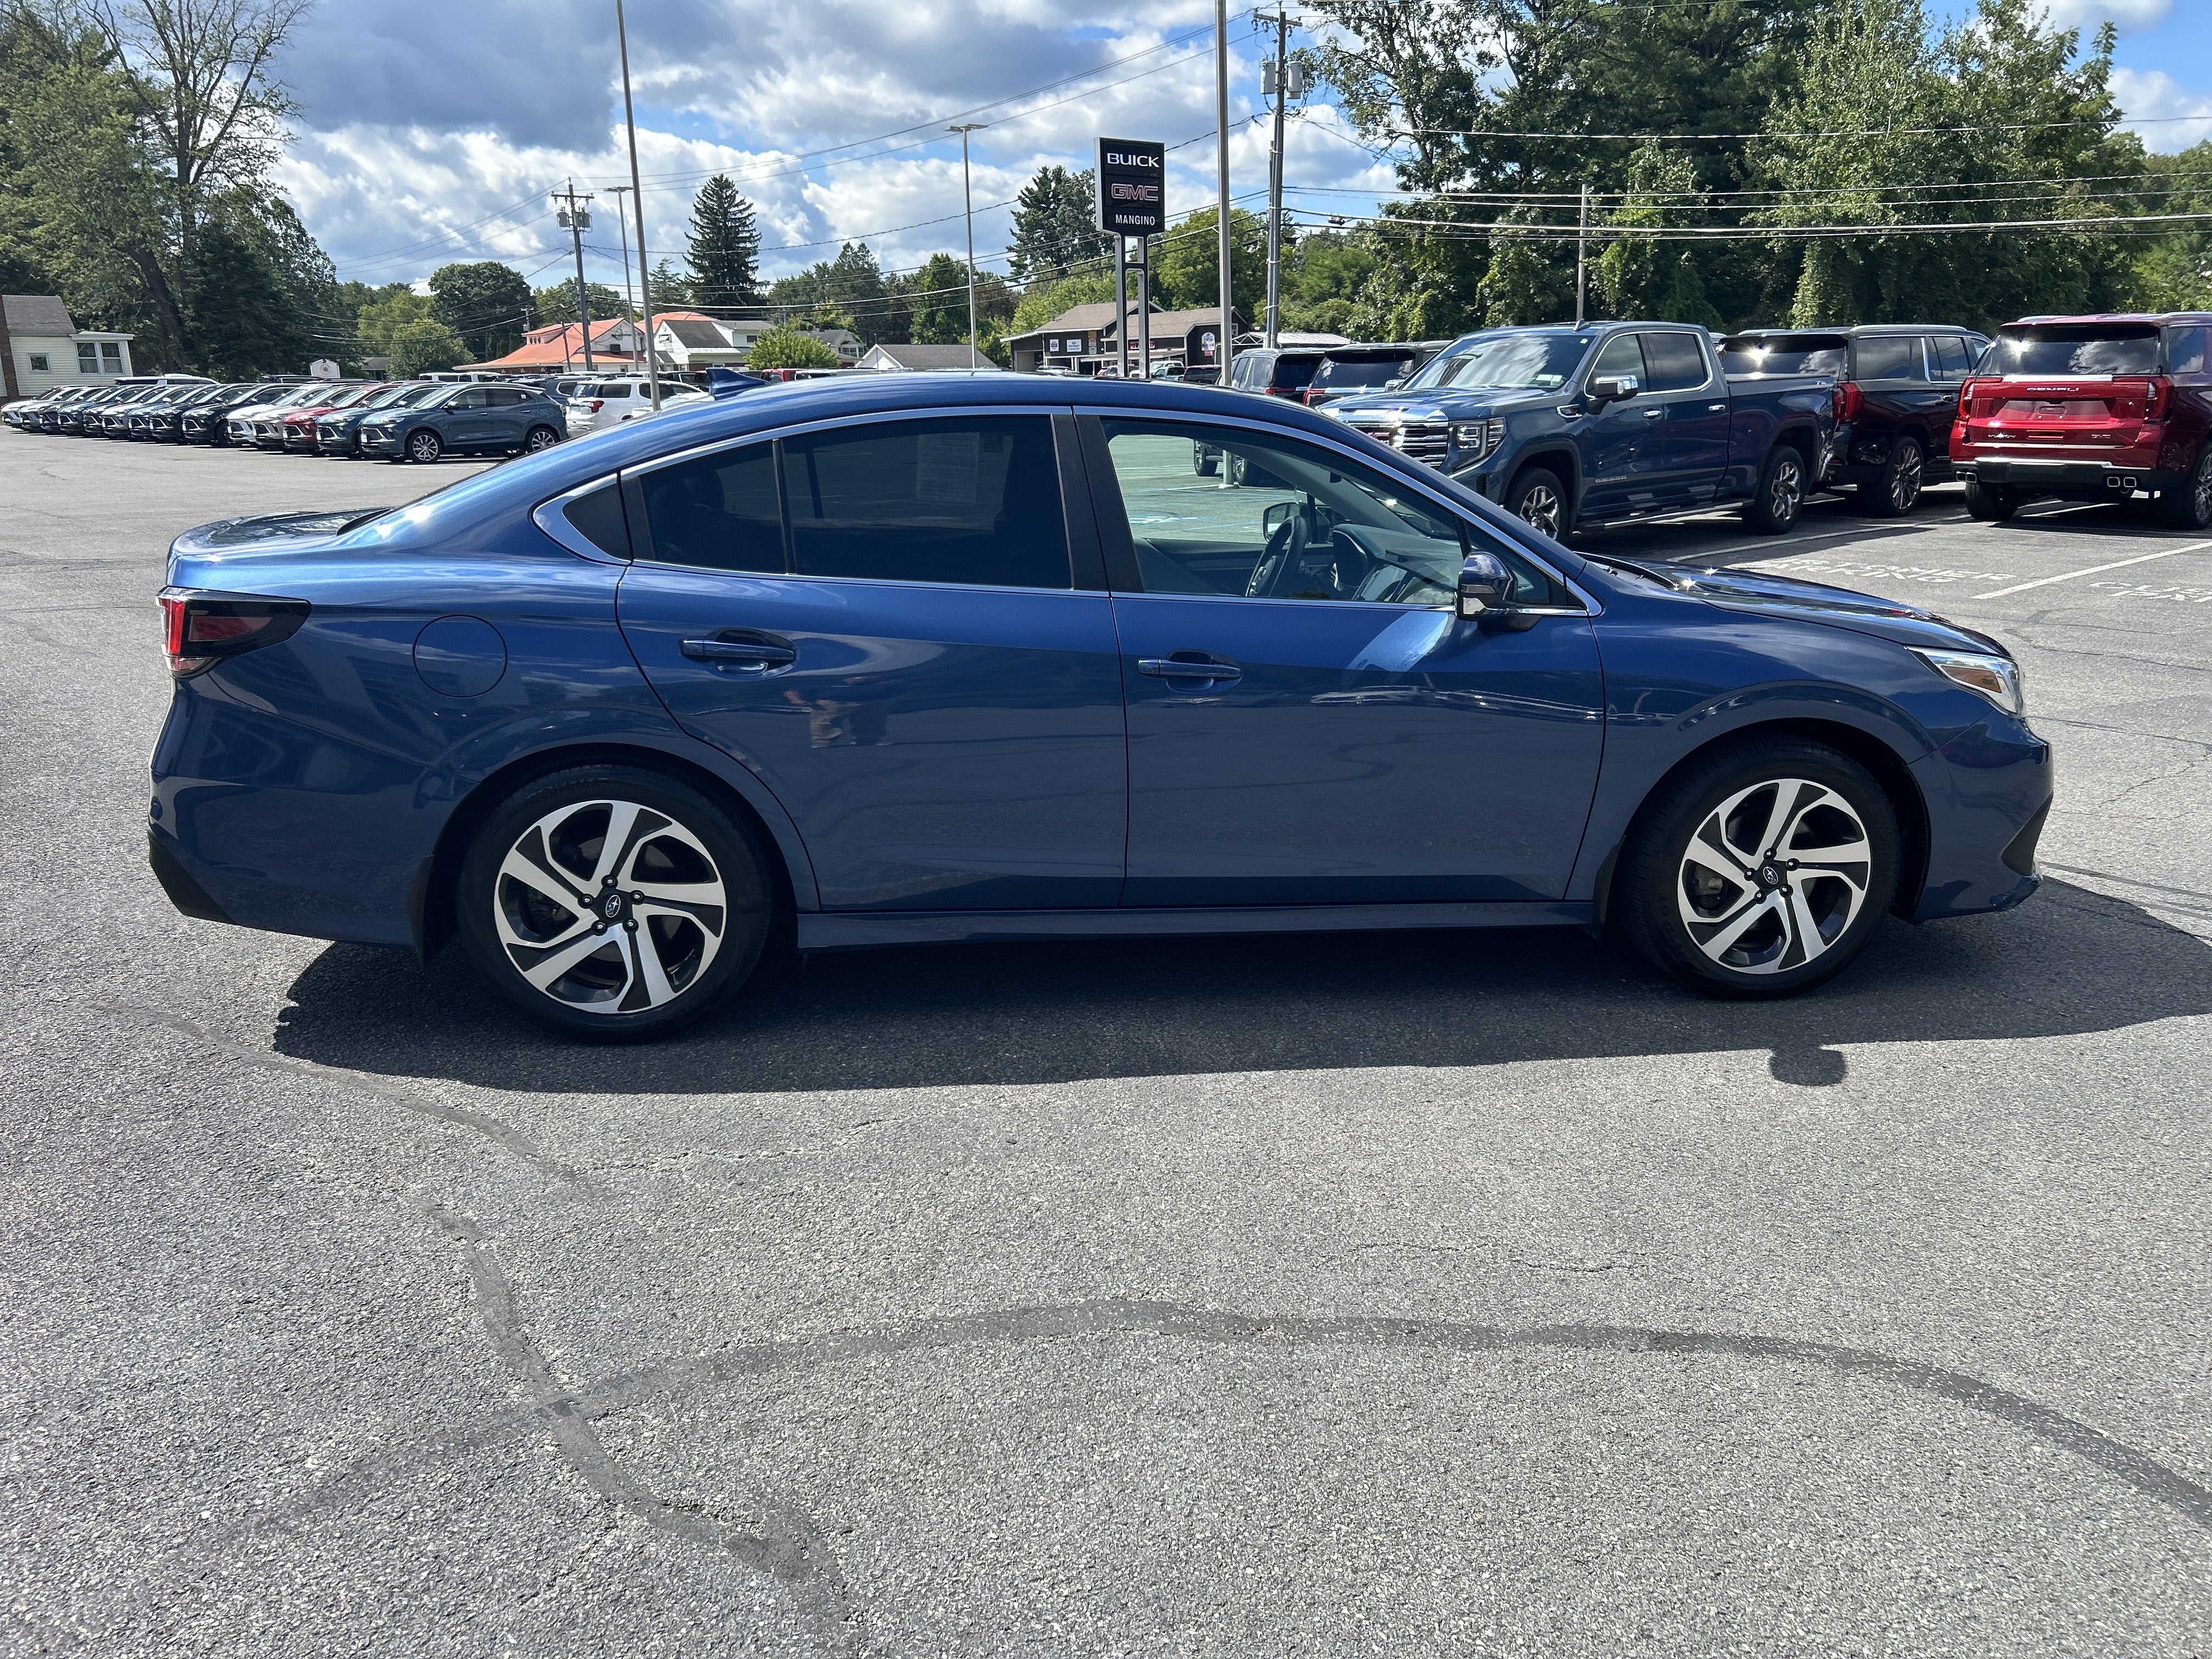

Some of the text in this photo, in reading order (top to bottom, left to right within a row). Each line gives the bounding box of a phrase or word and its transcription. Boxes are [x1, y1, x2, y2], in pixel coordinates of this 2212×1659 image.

[1107, 153, 1160, 168] BUICK
[1111, 183, 1159, 201] GMC
[1115, 214, 1155, 225] MANGINO
